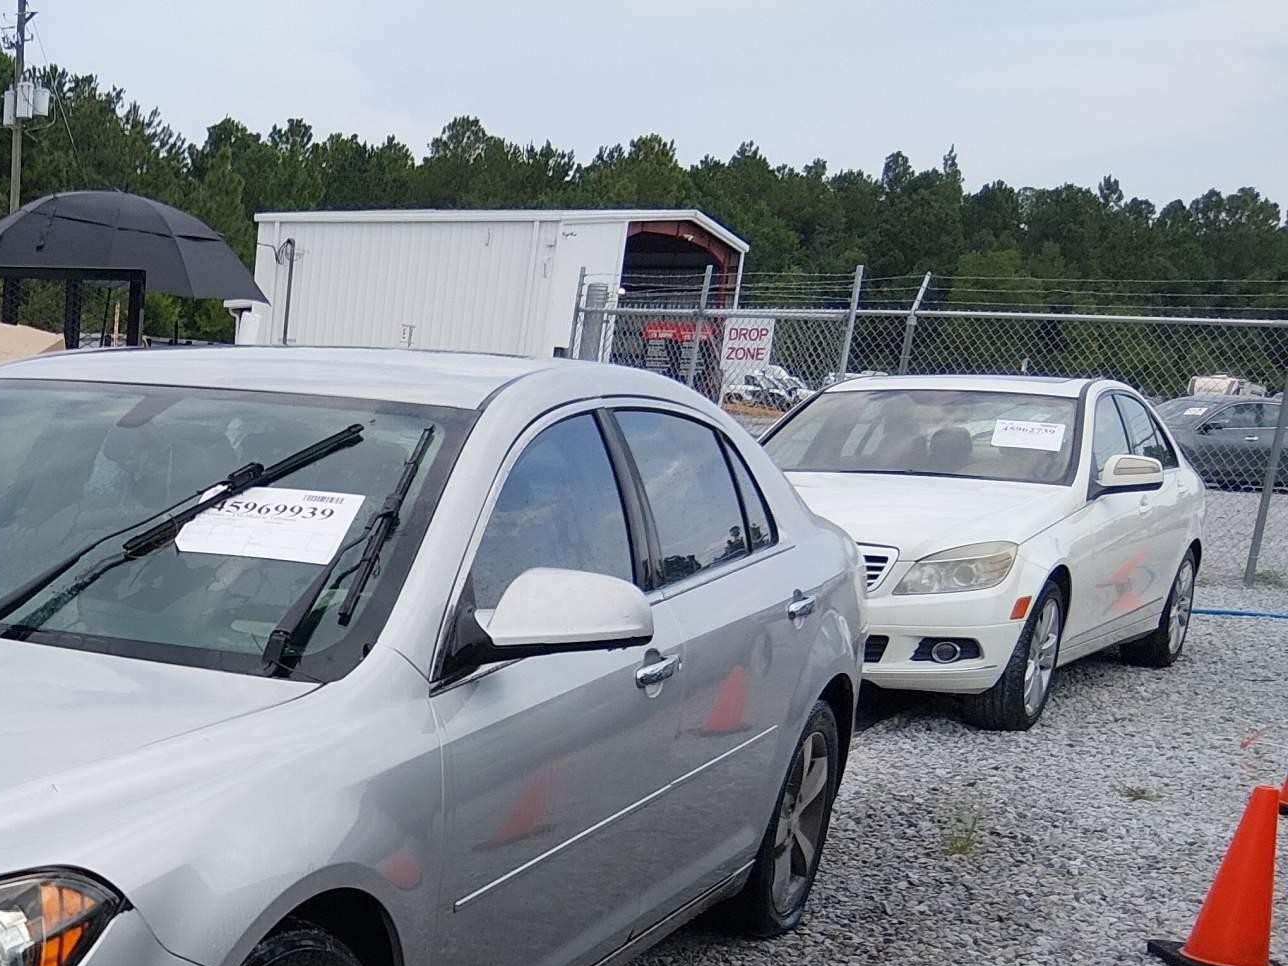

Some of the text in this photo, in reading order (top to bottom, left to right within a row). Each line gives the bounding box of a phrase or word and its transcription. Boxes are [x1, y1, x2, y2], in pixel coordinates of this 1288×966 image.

[729, 327, 769, 341] DROP
[726, 347, 765, 361] ZONE
[211, 500, 335, 521] 45969939
